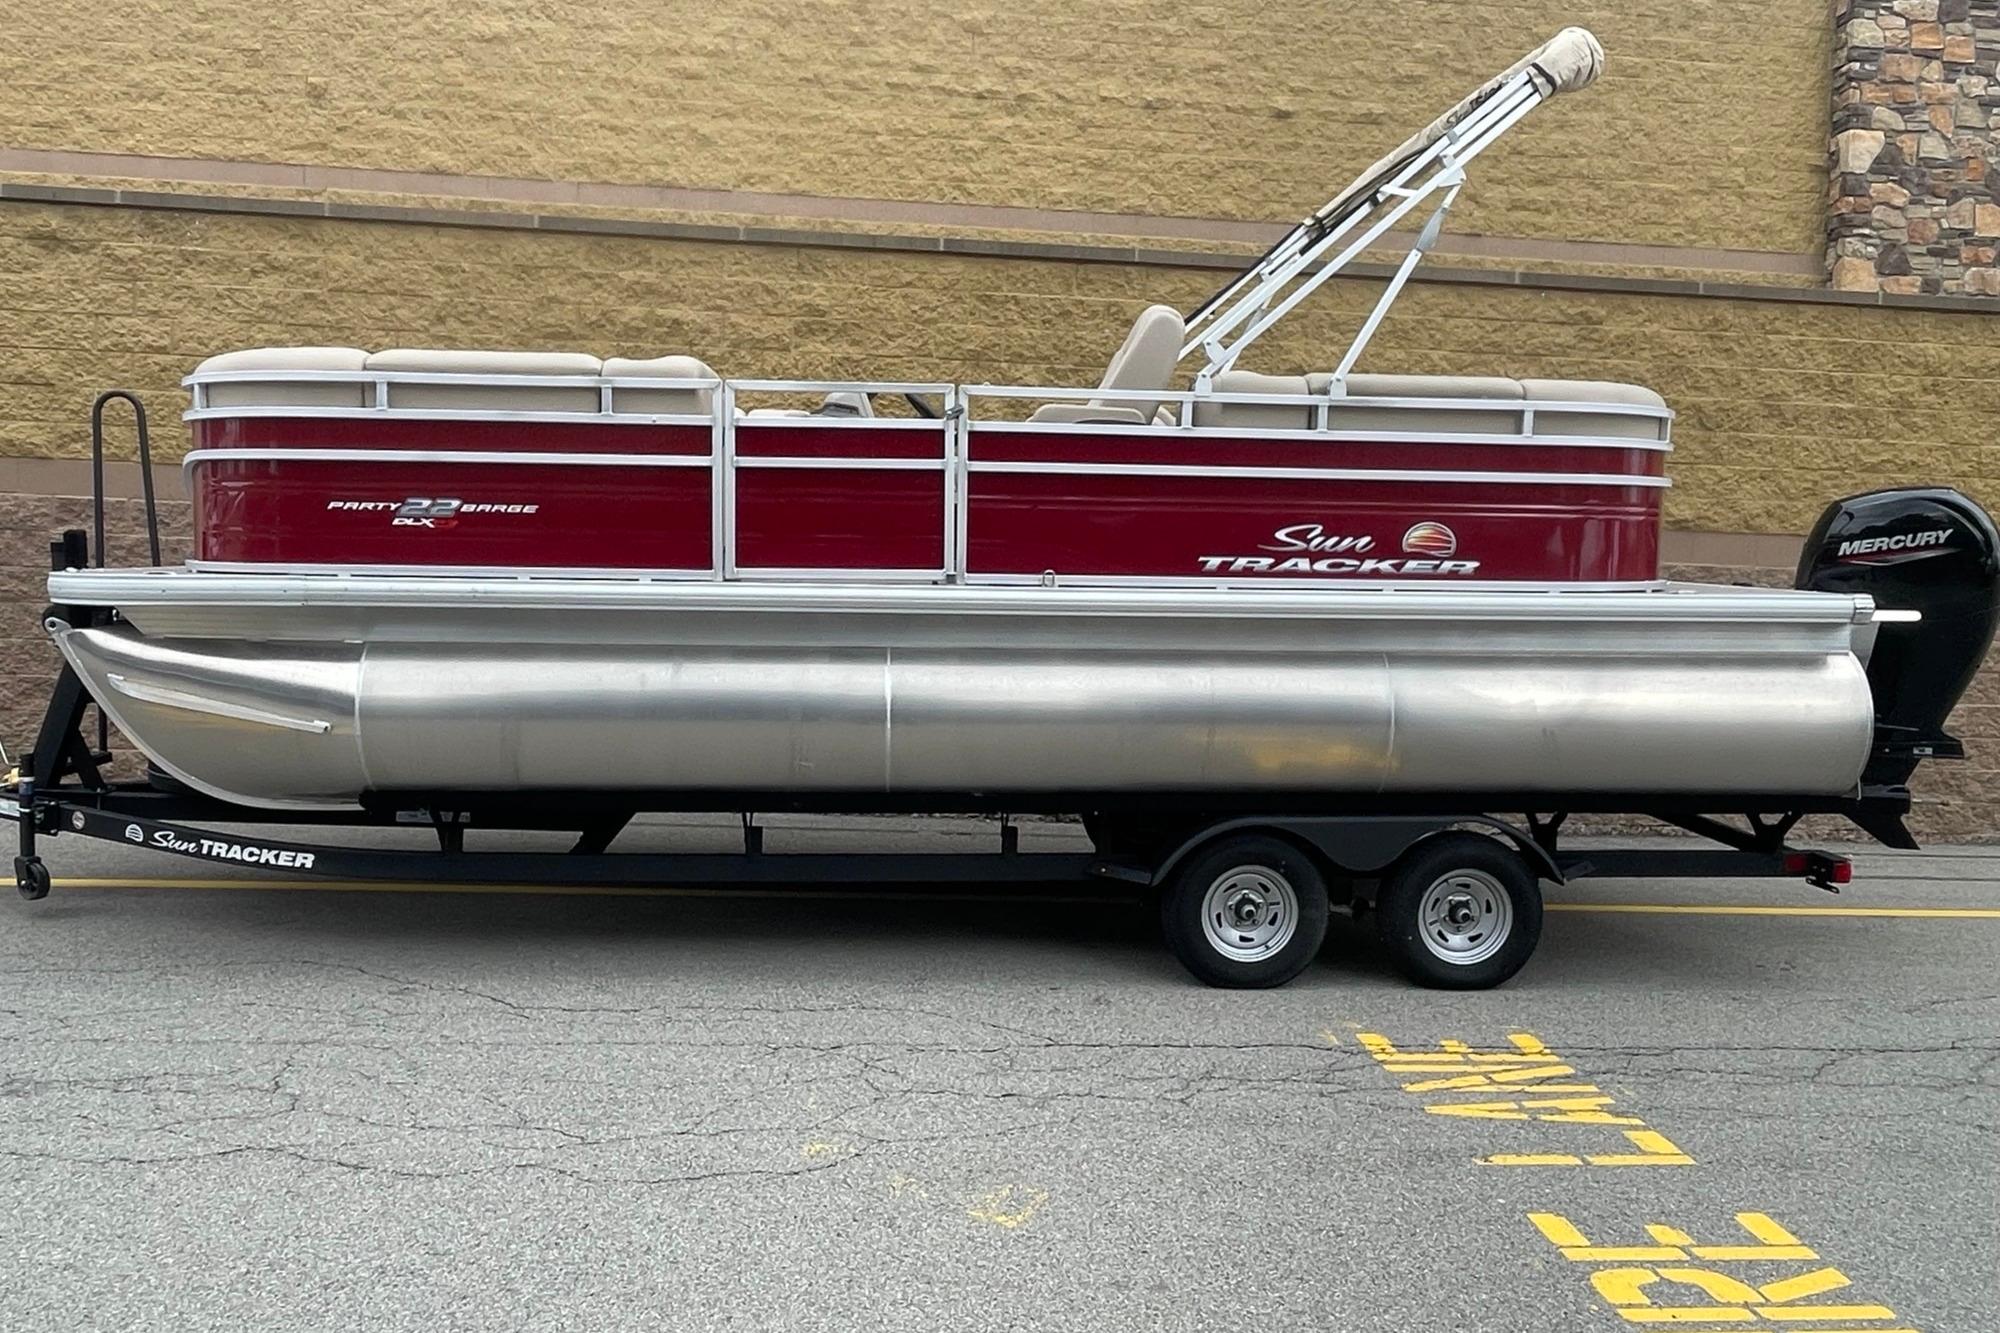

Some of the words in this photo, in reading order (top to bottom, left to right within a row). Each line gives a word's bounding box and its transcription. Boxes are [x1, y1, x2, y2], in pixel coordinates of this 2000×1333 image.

[327, 501, 403, 511] PARTY
[395, 497, 463, 518] 22
[460, 504, 539, 514] BARGE
[1257, 524, 1376, 553] Sun
[1837, 528, 1955, 556] MERCURY
[1198, 556, 1481, 575] TRACKER
[148, 831, 199, 853] Sun
[199, 839, 316, 869] TRACKER
[1356, 1033, 1697, 1166] LANE
